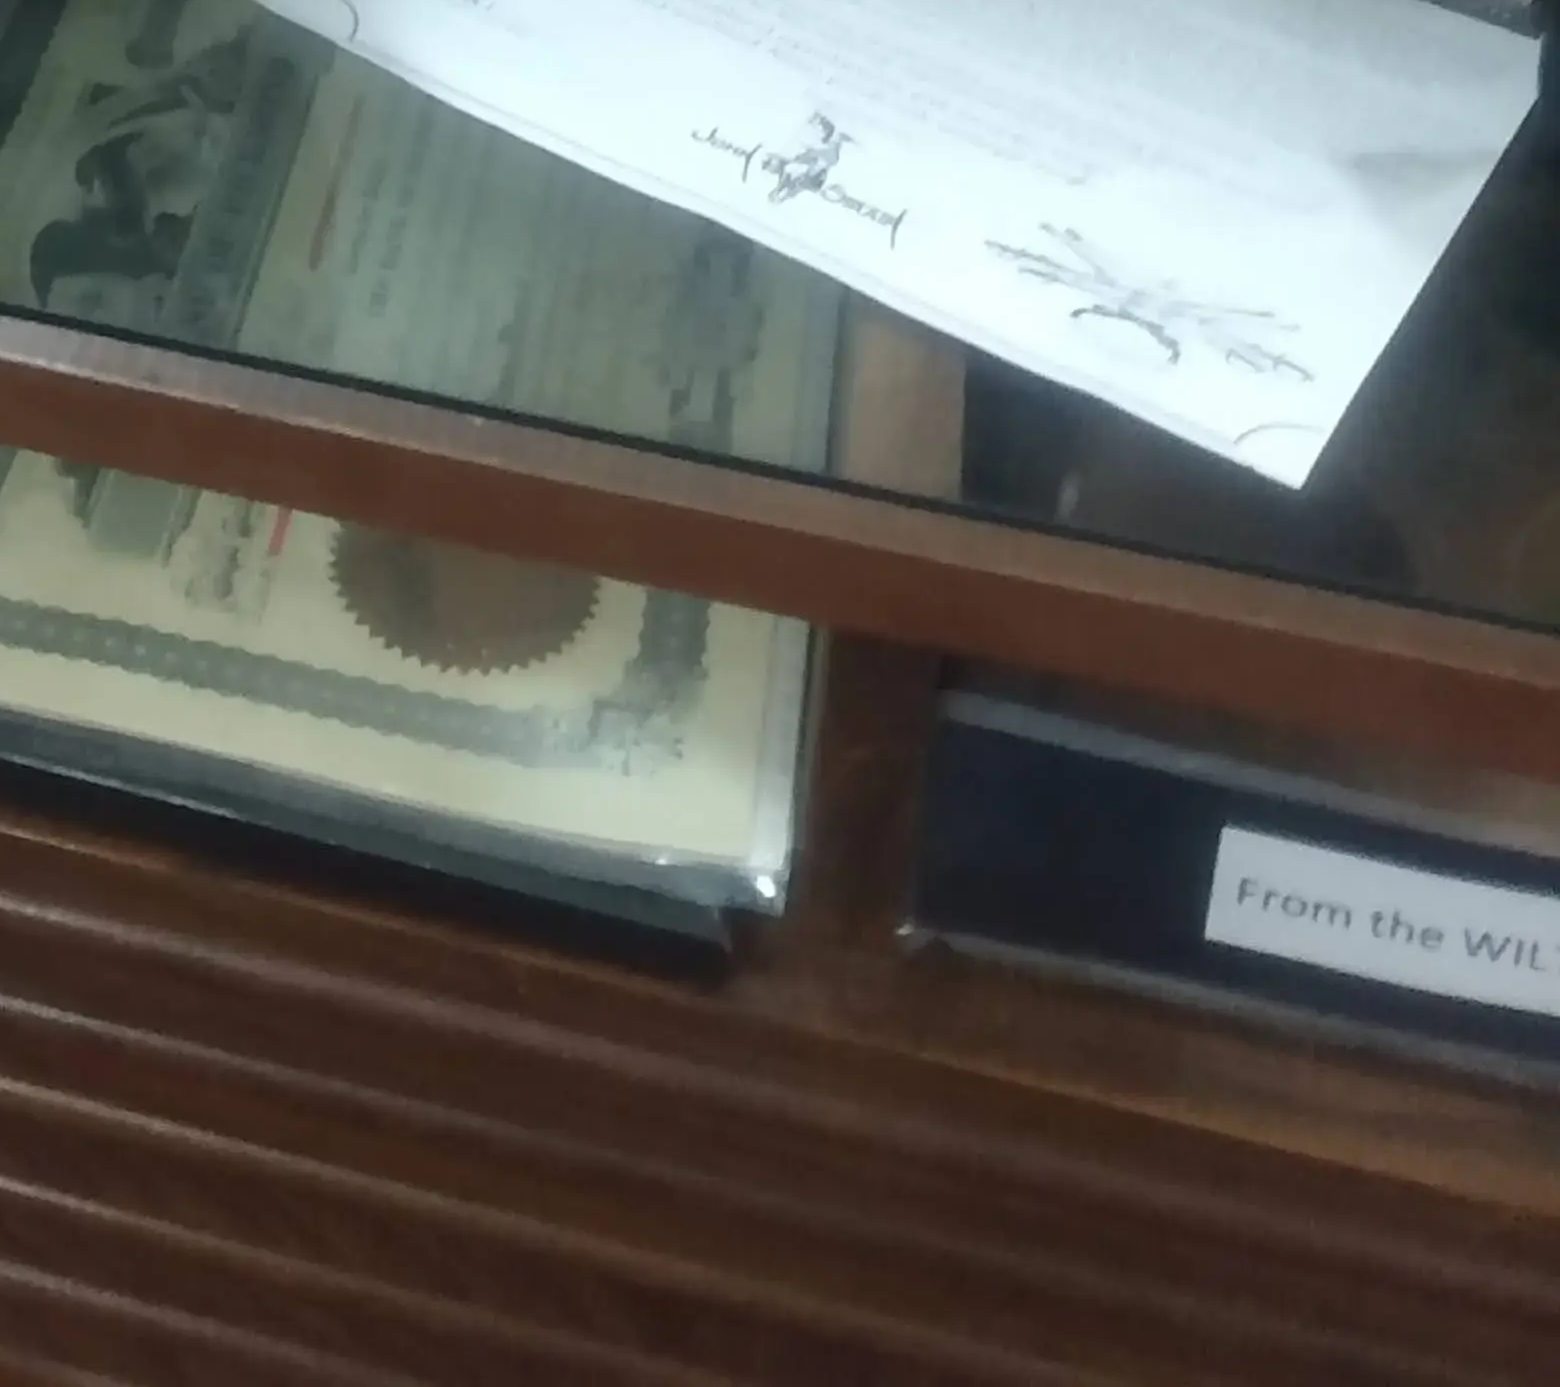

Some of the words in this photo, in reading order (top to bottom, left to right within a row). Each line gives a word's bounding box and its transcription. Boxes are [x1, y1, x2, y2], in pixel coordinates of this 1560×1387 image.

[1236, 877, 1353, 930] From
[1369, 909, 1446, 951] the
[1462, 925, 1560, 973] WIL
